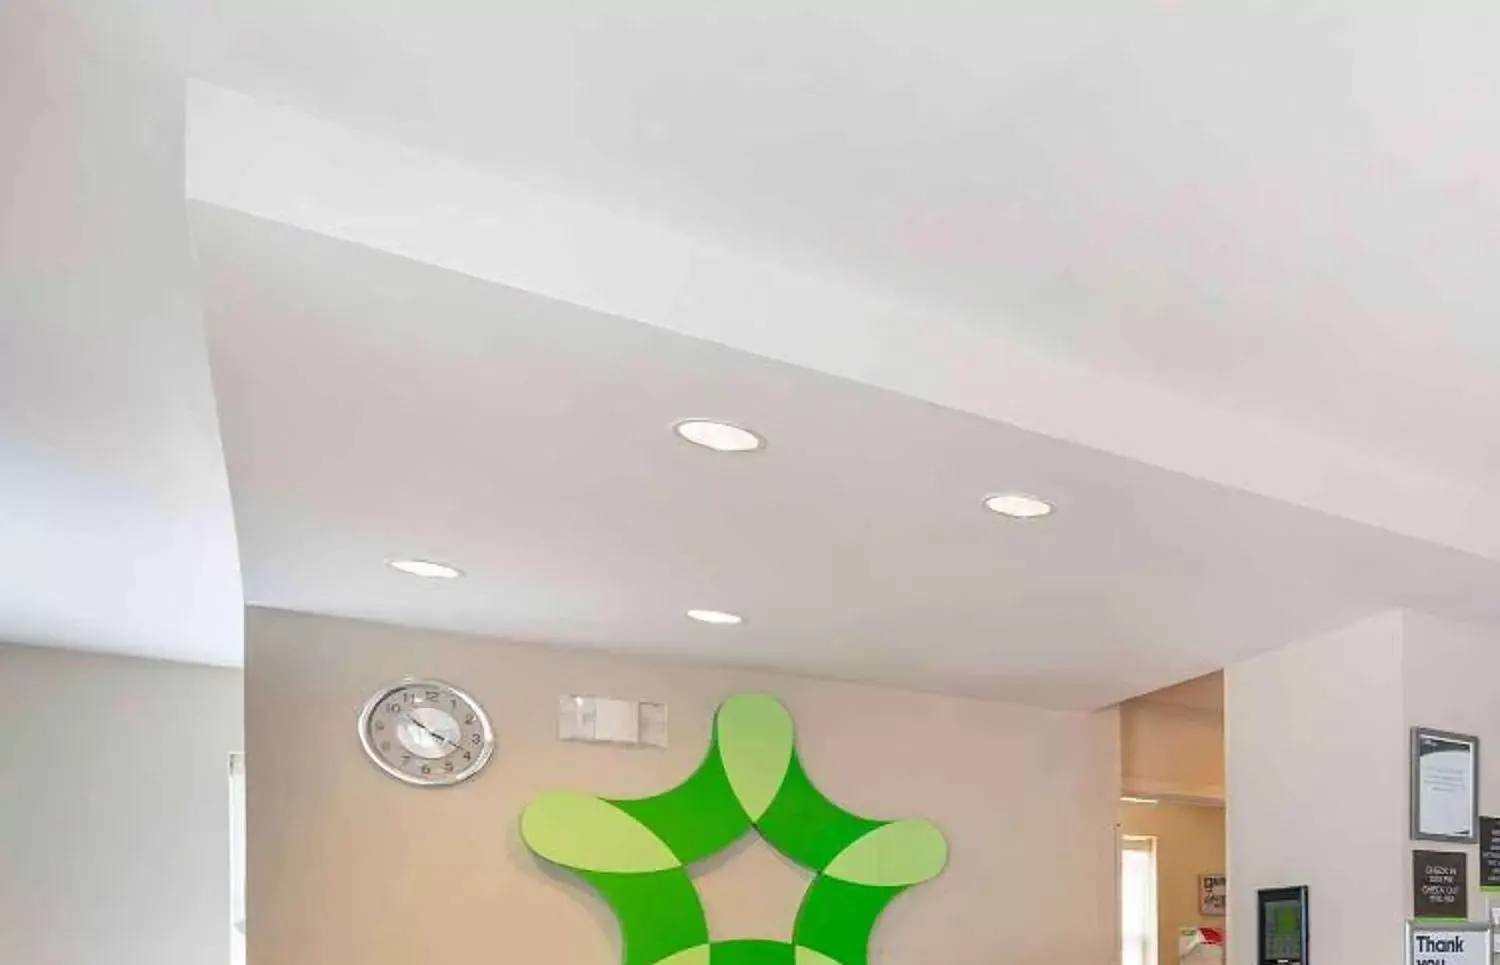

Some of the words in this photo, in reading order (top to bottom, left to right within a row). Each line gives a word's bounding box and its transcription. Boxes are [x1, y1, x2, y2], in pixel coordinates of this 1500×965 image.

[403, 693, 415, 704] 11
[425, 691, 439, 702] 12
[450, 699, 457, 711] 1
[471, 734, 481, 745] 3
[463, 751, 471, 761] 4
[1416, 936, 1464, 953] Thank
